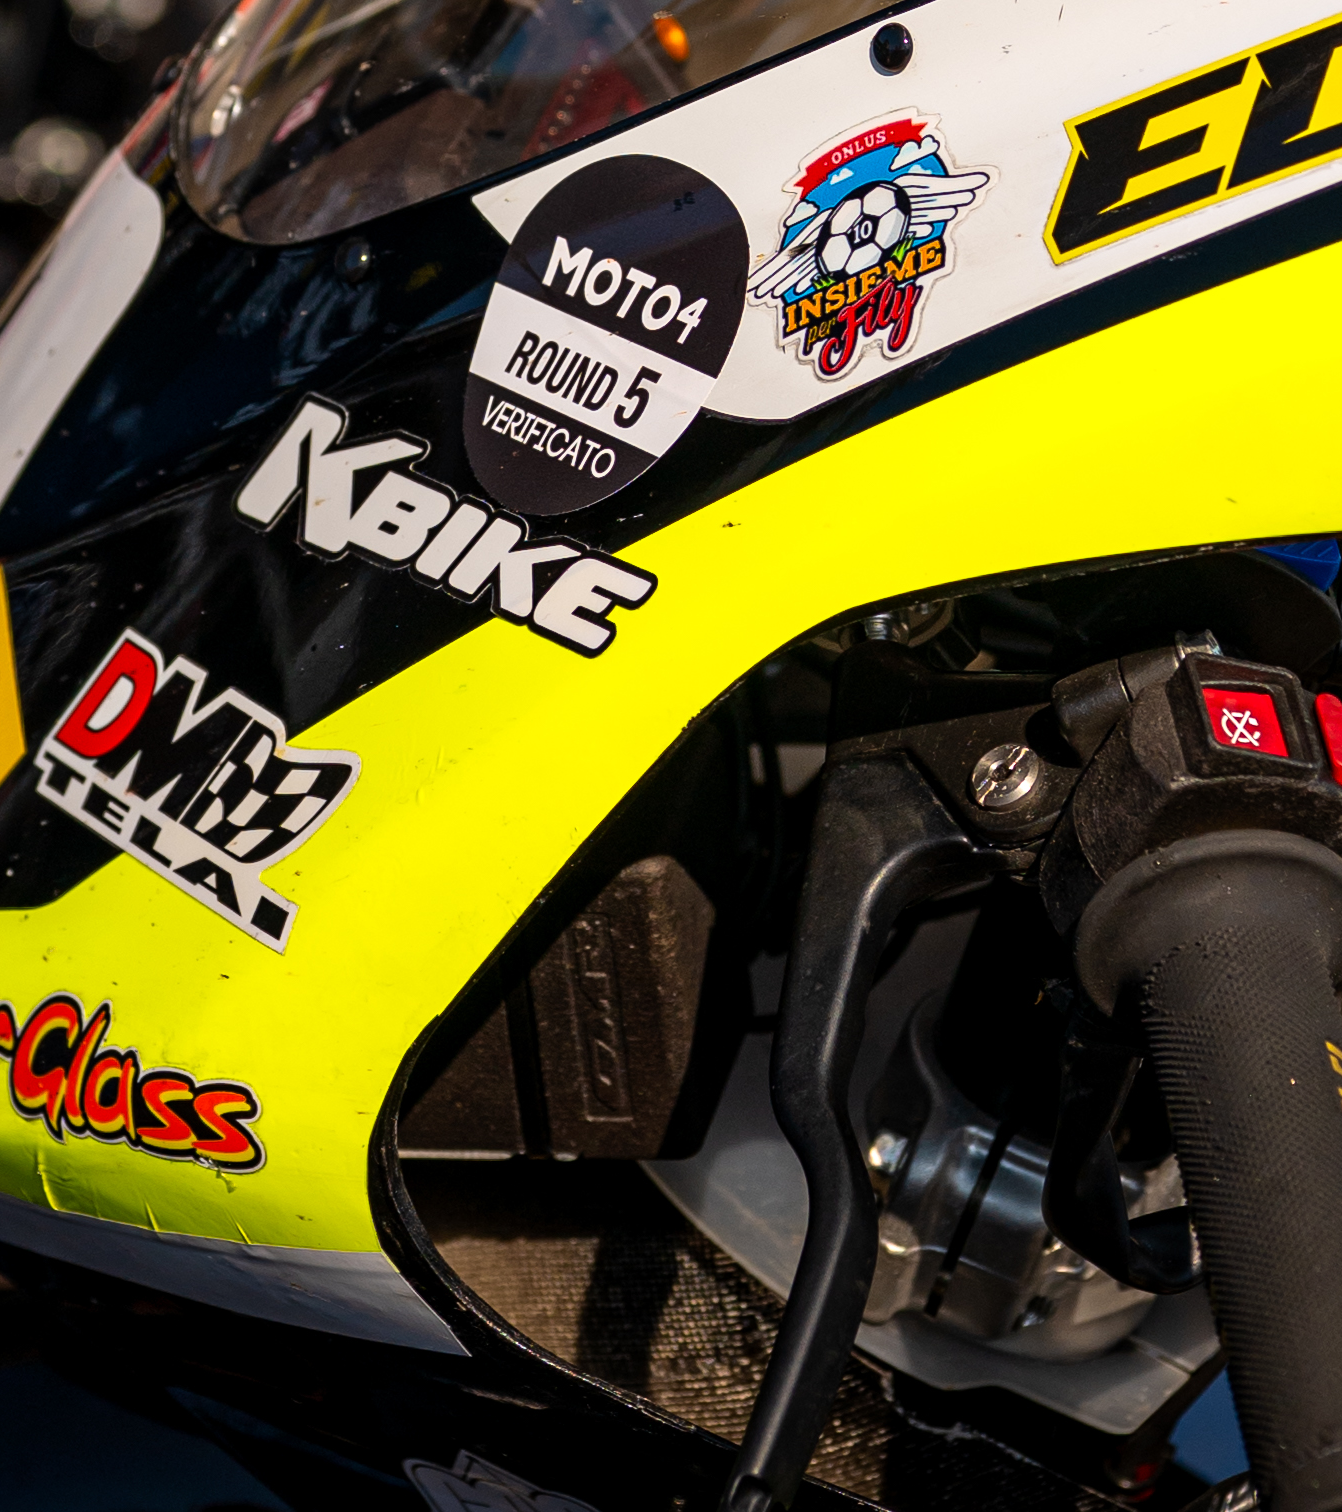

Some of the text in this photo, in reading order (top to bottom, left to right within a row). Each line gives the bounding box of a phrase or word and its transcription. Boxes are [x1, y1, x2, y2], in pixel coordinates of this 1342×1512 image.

[830, 130, 886, 166] ONLUS
[852, 220, 872, 244] 10
[542, 235, 708, 345] MOTO4
[785, 239, 942, 333] INSIEME
[818, 275, 924, 374] Fily
[504, 330, 663, 429] ROUND 5
[482, 395, 616, 478] VERIFICATO
[236, 403, 653, 650] KBIKE
[43, 750, 291, 942] TELAI
